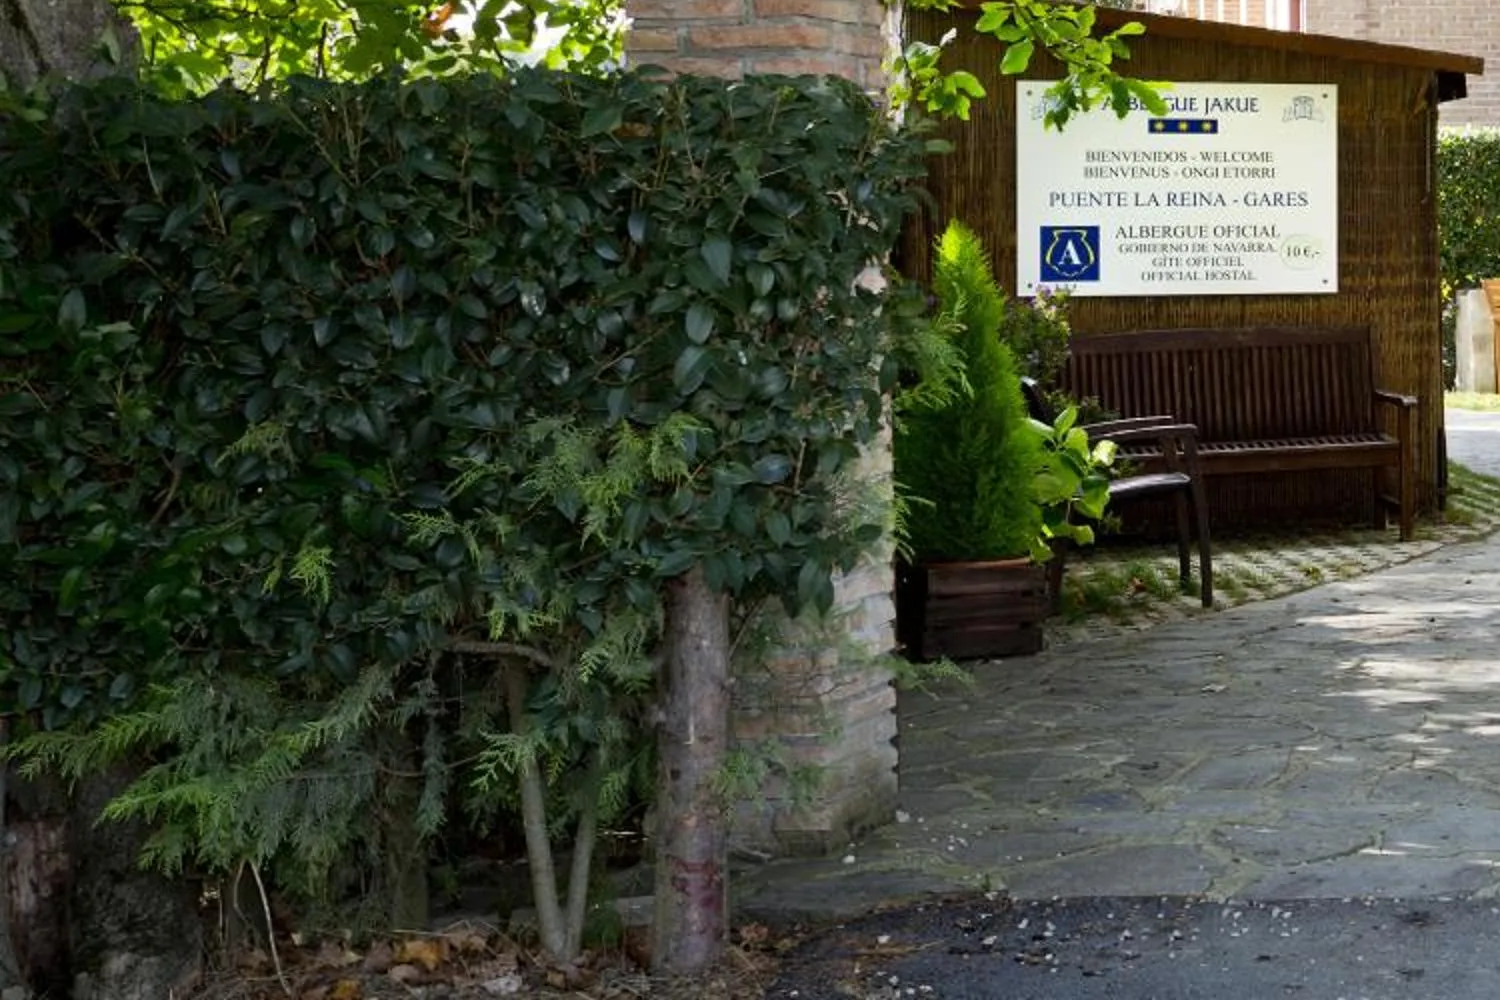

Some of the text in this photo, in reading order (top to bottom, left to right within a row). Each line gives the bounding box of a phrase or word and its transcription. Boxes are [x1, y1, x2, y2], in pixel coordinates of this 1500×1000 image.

[1204, 97, 1260, 114] JAKUE
[1085, 150, 1187, 163] BIENVENIDOS
[1200, 150, 1274, 163] WELCOME
[1083, 166, 1171, 179] BIENVENUS
[1181, 166, 1219, 179] ONGI
[1222, 166, 1276, 179] ETORRI
[1049, 191, 1128, 207] PUENTE
[1134, 191, 1160, 207] LA
[1166, 191, 1227, 207] REINA
[1243, 191, 1309, 207] GARES
[1115, 224, 1281, 239] ALBERGUE OFICIAL
[1118, 243, 1189, 254] GOBIERNO
[1191, 243, 1208, 254] DE
[1205, 270, 1257, 281] HOSTAL
